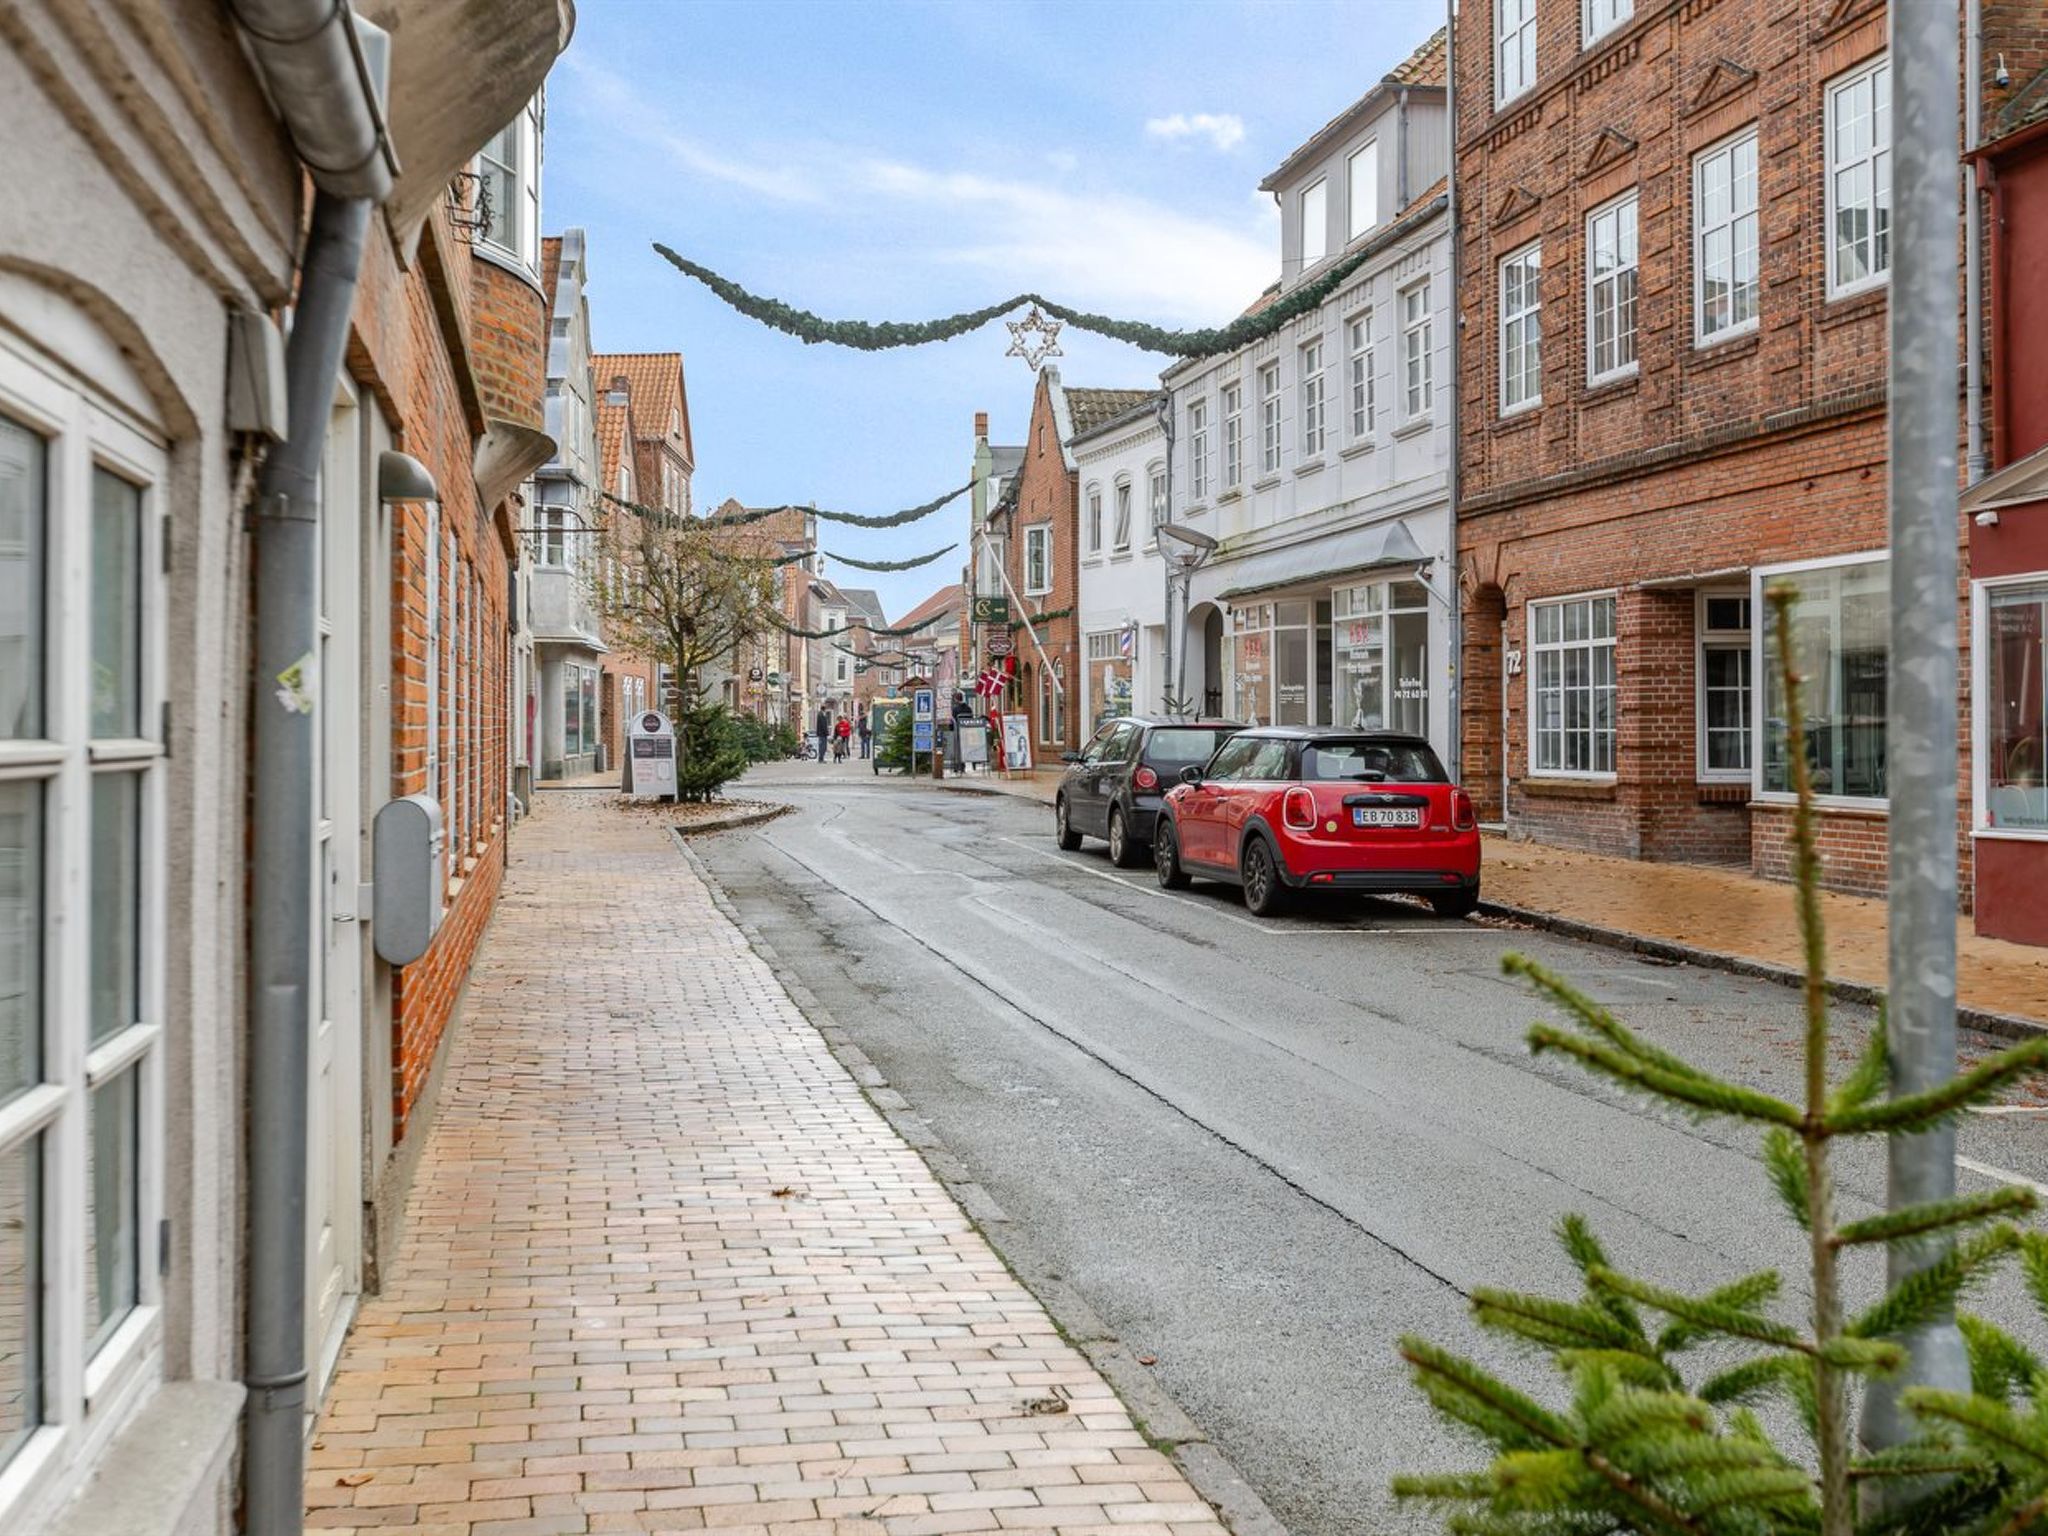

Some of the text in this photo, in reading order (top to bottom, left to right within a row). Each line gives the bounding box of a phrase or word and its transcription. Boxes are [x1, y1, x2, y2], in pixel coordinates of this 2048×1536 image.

[1506, 650, 1521, 674] 72
[1362, 811, 1417, 822] EB 70 838
